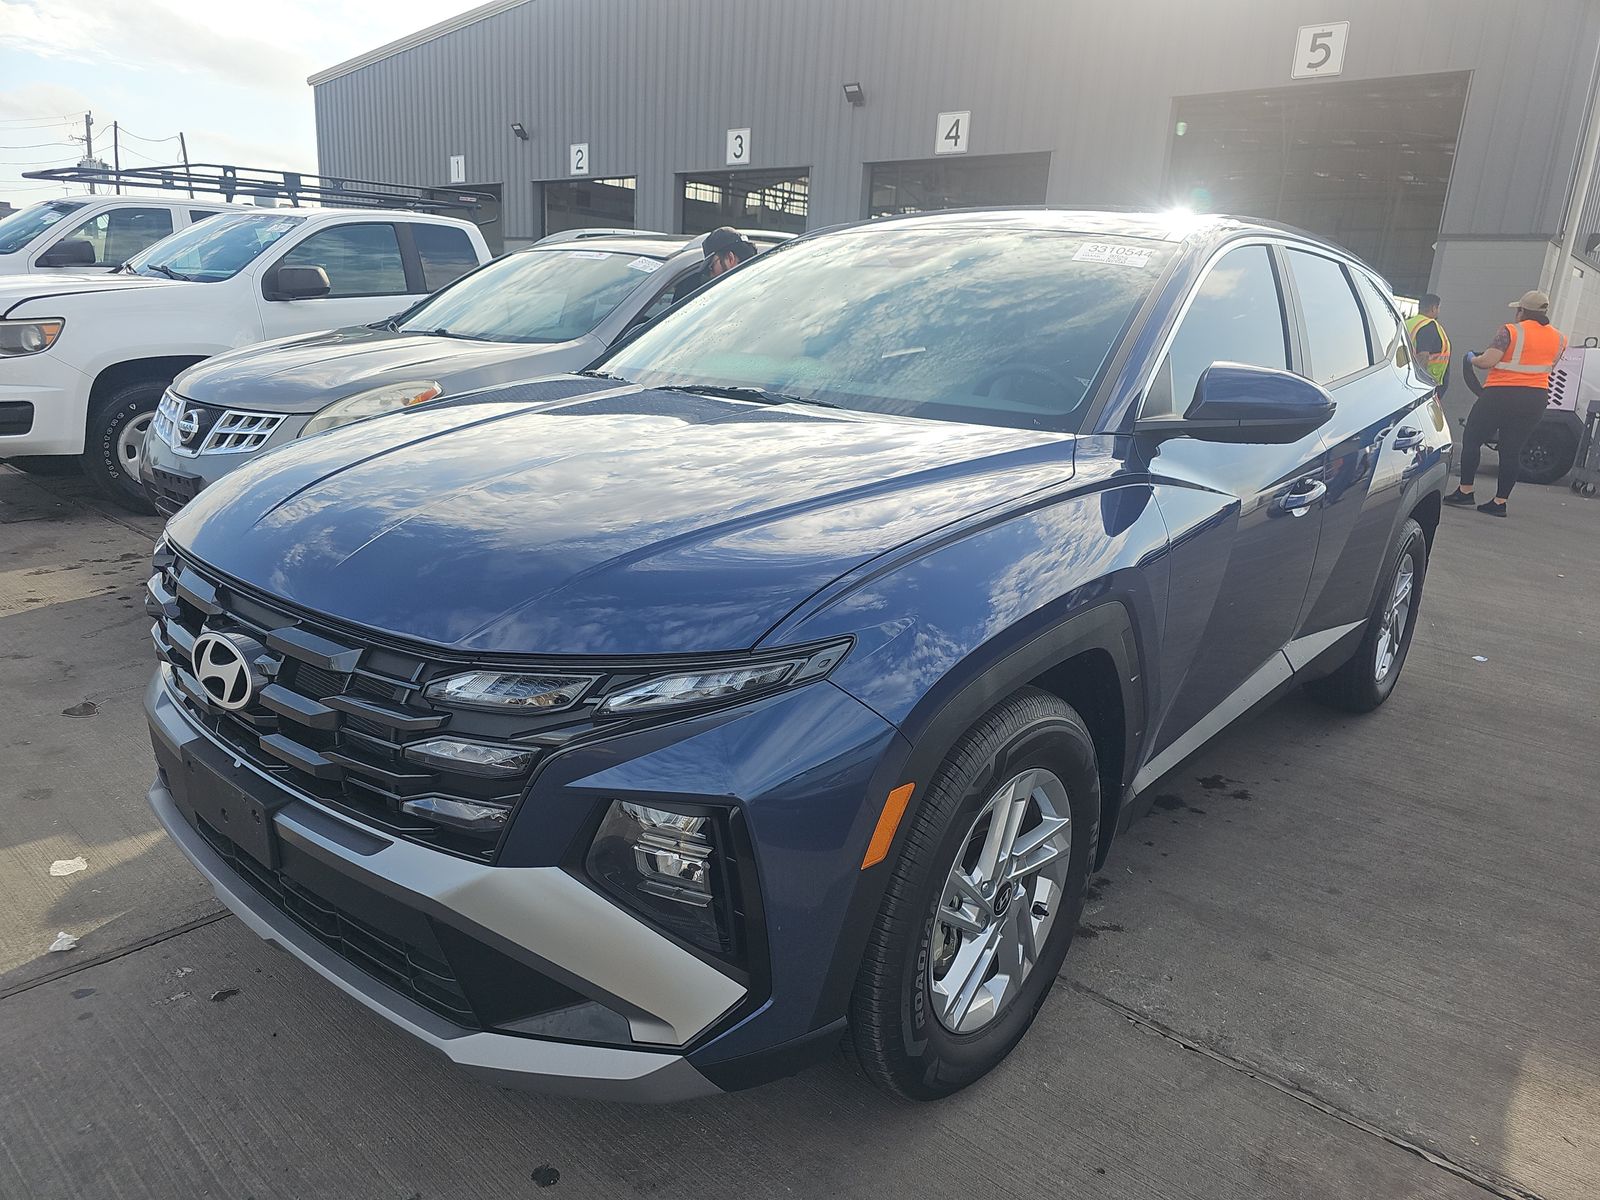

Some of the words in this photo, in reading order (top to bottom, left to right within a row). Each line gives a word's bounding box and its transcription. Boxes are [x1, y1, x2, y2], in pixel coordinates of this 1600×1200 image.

[1306, 31, 1333, 69] 5
[944, 118, 961, 147] 4
[733, 134, 744, 159] 3
[575, 149, 584, 170] 2
[1088, 244, 1153, 258] 3310544
